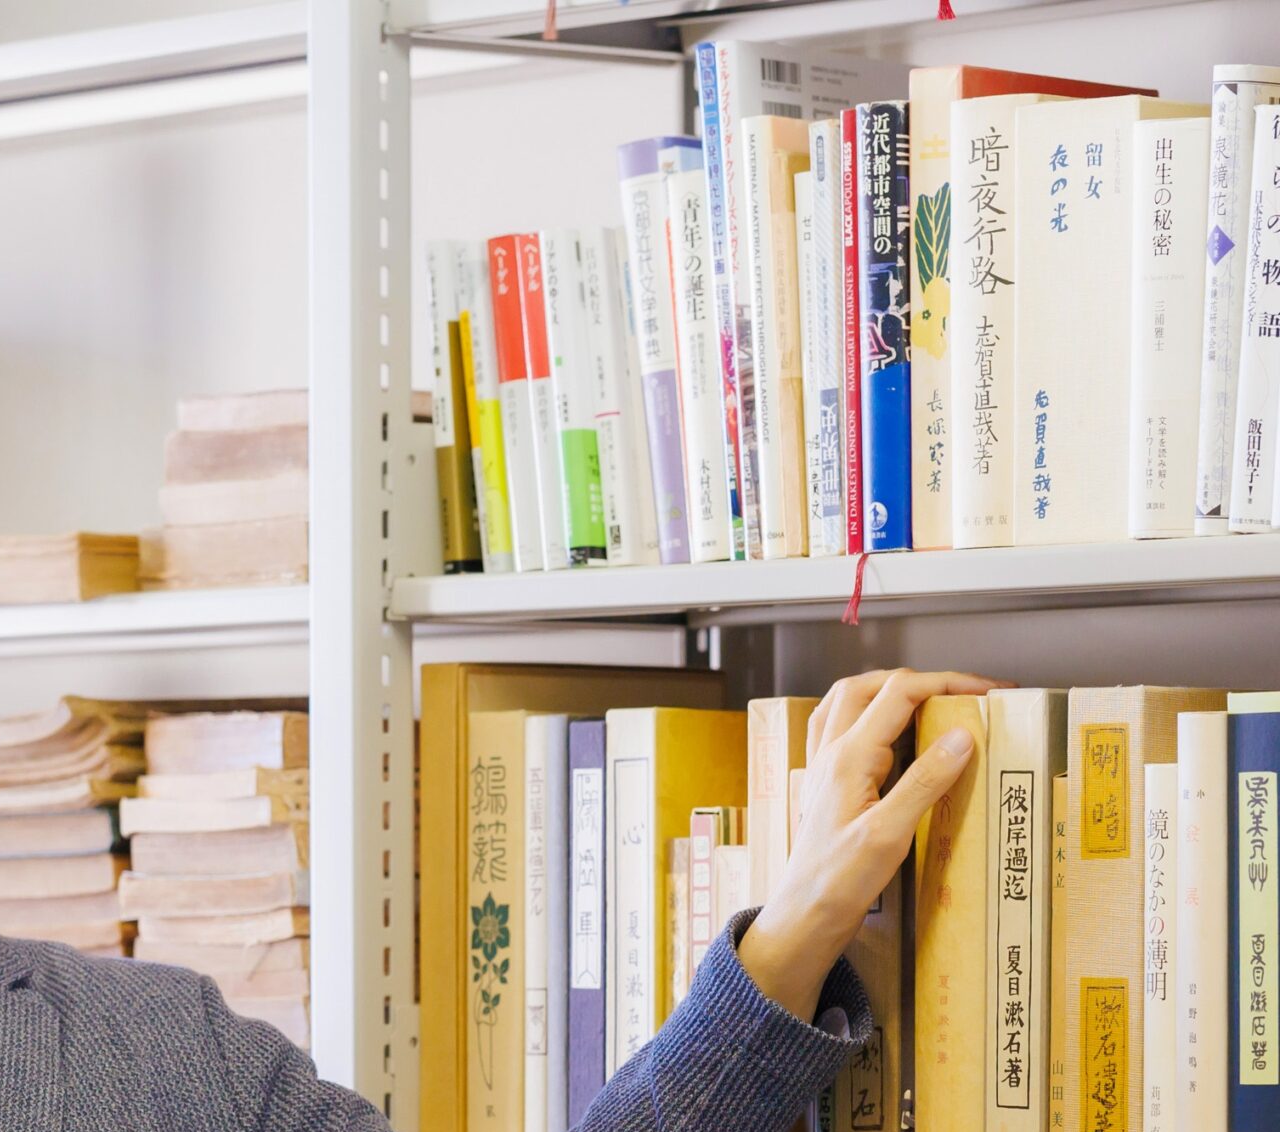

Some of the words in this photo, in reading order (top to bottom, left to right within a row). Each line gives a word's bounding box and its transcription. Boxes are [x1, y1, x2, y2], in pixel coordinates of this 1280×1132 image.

[872, 112, 892, 255] 近代都市空間の
[963, 126, 1015, 296] 暗夜行路
[1048, 144, 1069, 233] 夜の光
[1084, 142, 1104, 200] 留女
[1152, 137, 1173, 257] 出生の秘密
[845, 265, 856, 326] HARKNESS
[846, 328, 857, 392] MARGARET
[970, 315, 1000, 476] 志賀直哉著
[760, 369, 770, 444] LANGUAGE
[847, 409, 857, 468] LONDON
[1032, 389, 1052, 520] 志賀直哉著
[1245, 418, 1264, 485] 飯田祐子
[848, 470, 858, 518] DARKEST
[850, 520, 858, 536] IN
[1000, 784, 1029, 901] 彼岸過迄
[1053, 821, 1067, 889] 夏木立
[1146, 808, 1170, 1002] 鏡のなかの薄明
[1001, 945, 1025, 1088] 夏目漱石著
